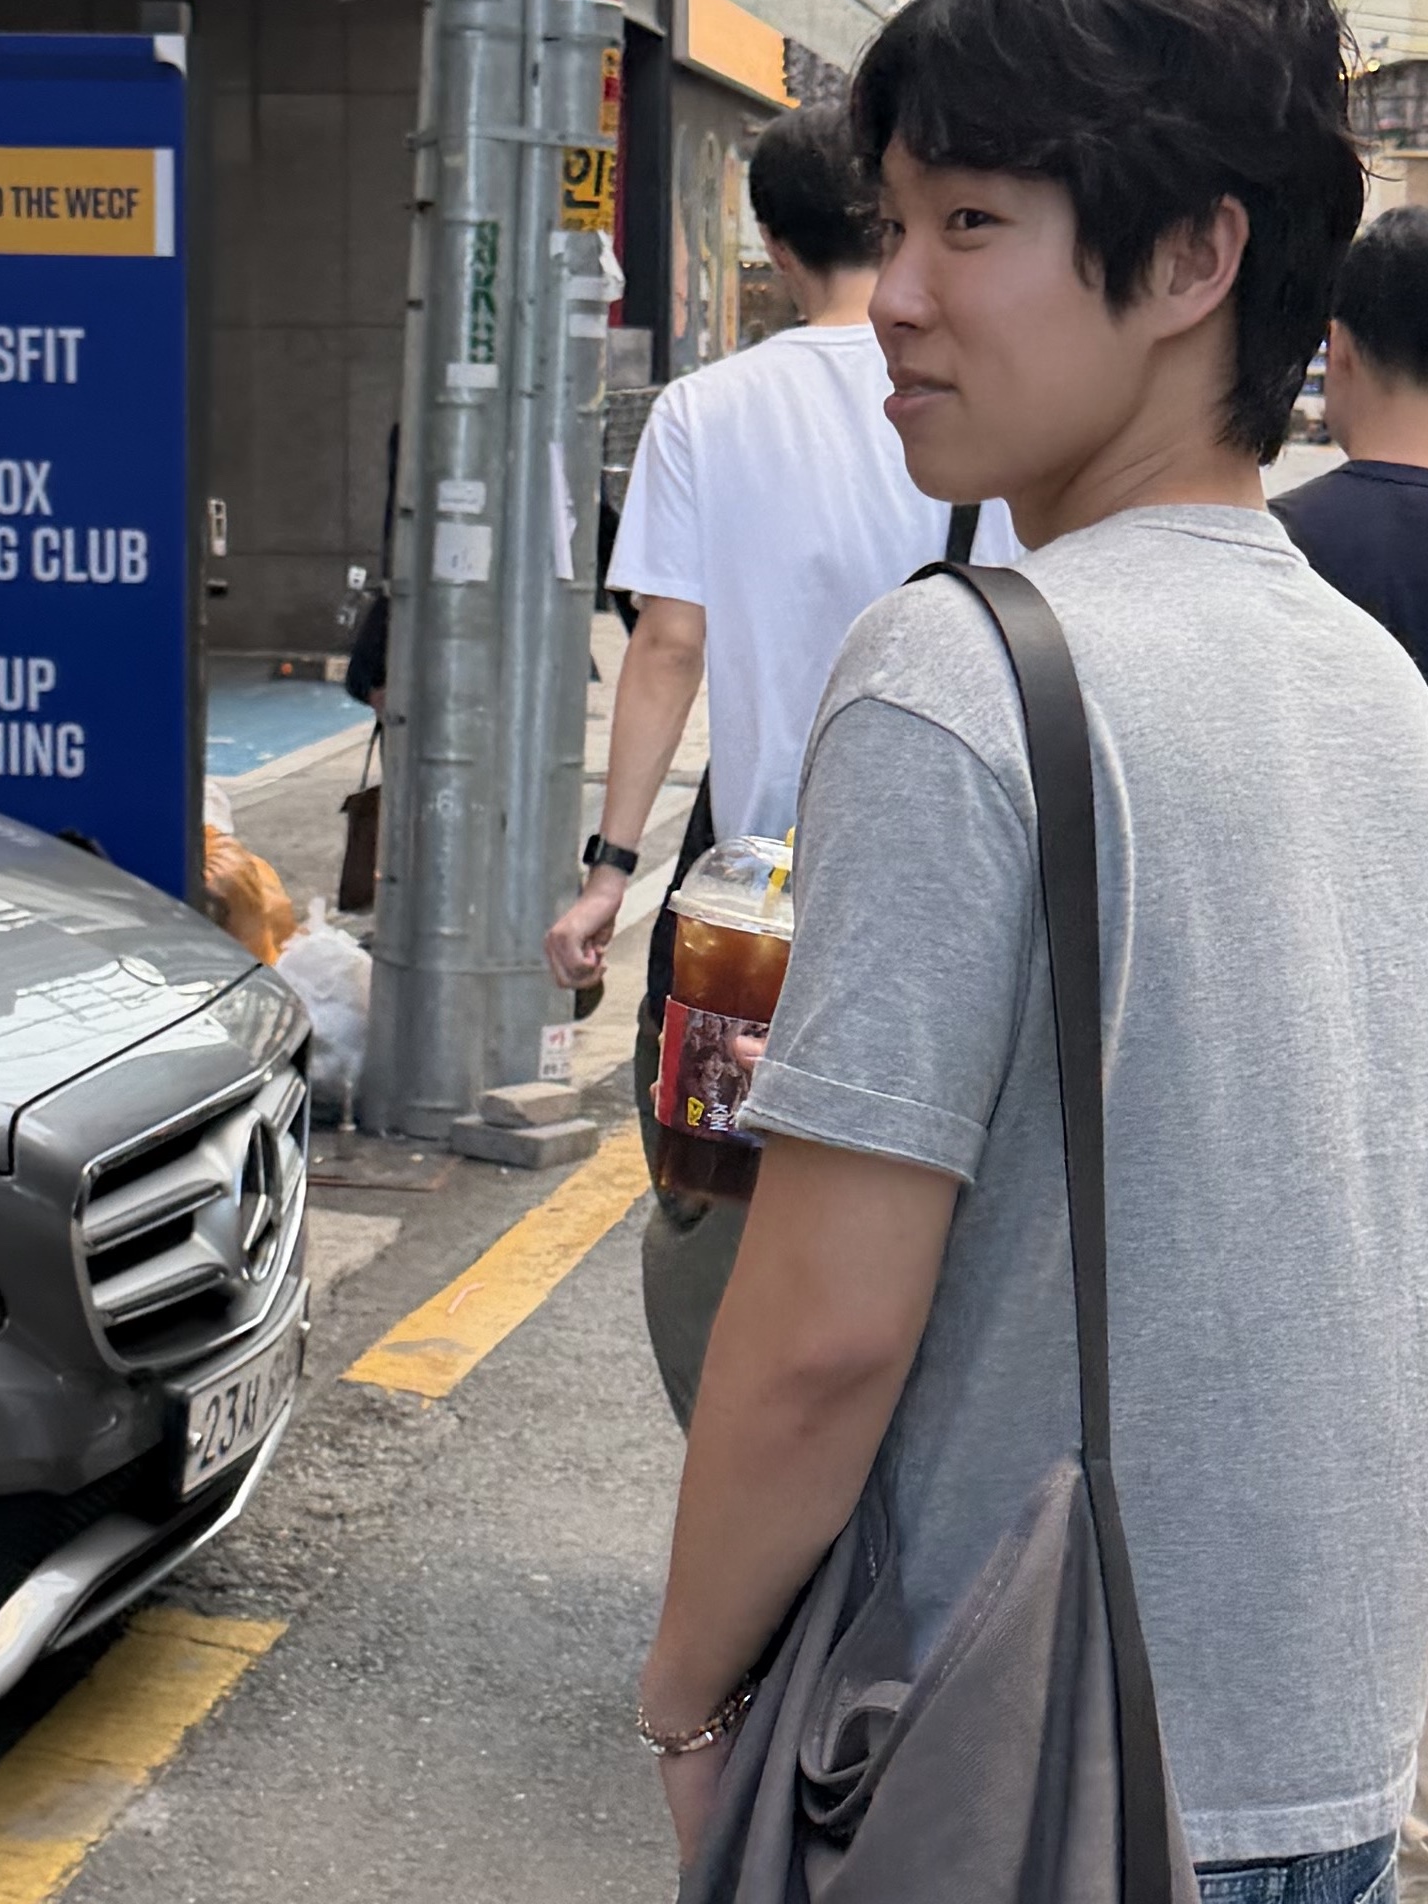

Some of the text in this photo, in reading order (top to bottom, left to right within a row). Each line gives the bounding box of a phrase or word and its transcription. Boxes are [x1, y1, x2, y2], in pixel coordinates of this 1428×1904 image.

[10, 184, 59, 219] THE
[64, 185, 140, 221] WECF
[32, 527, 150, 585] CLUB
